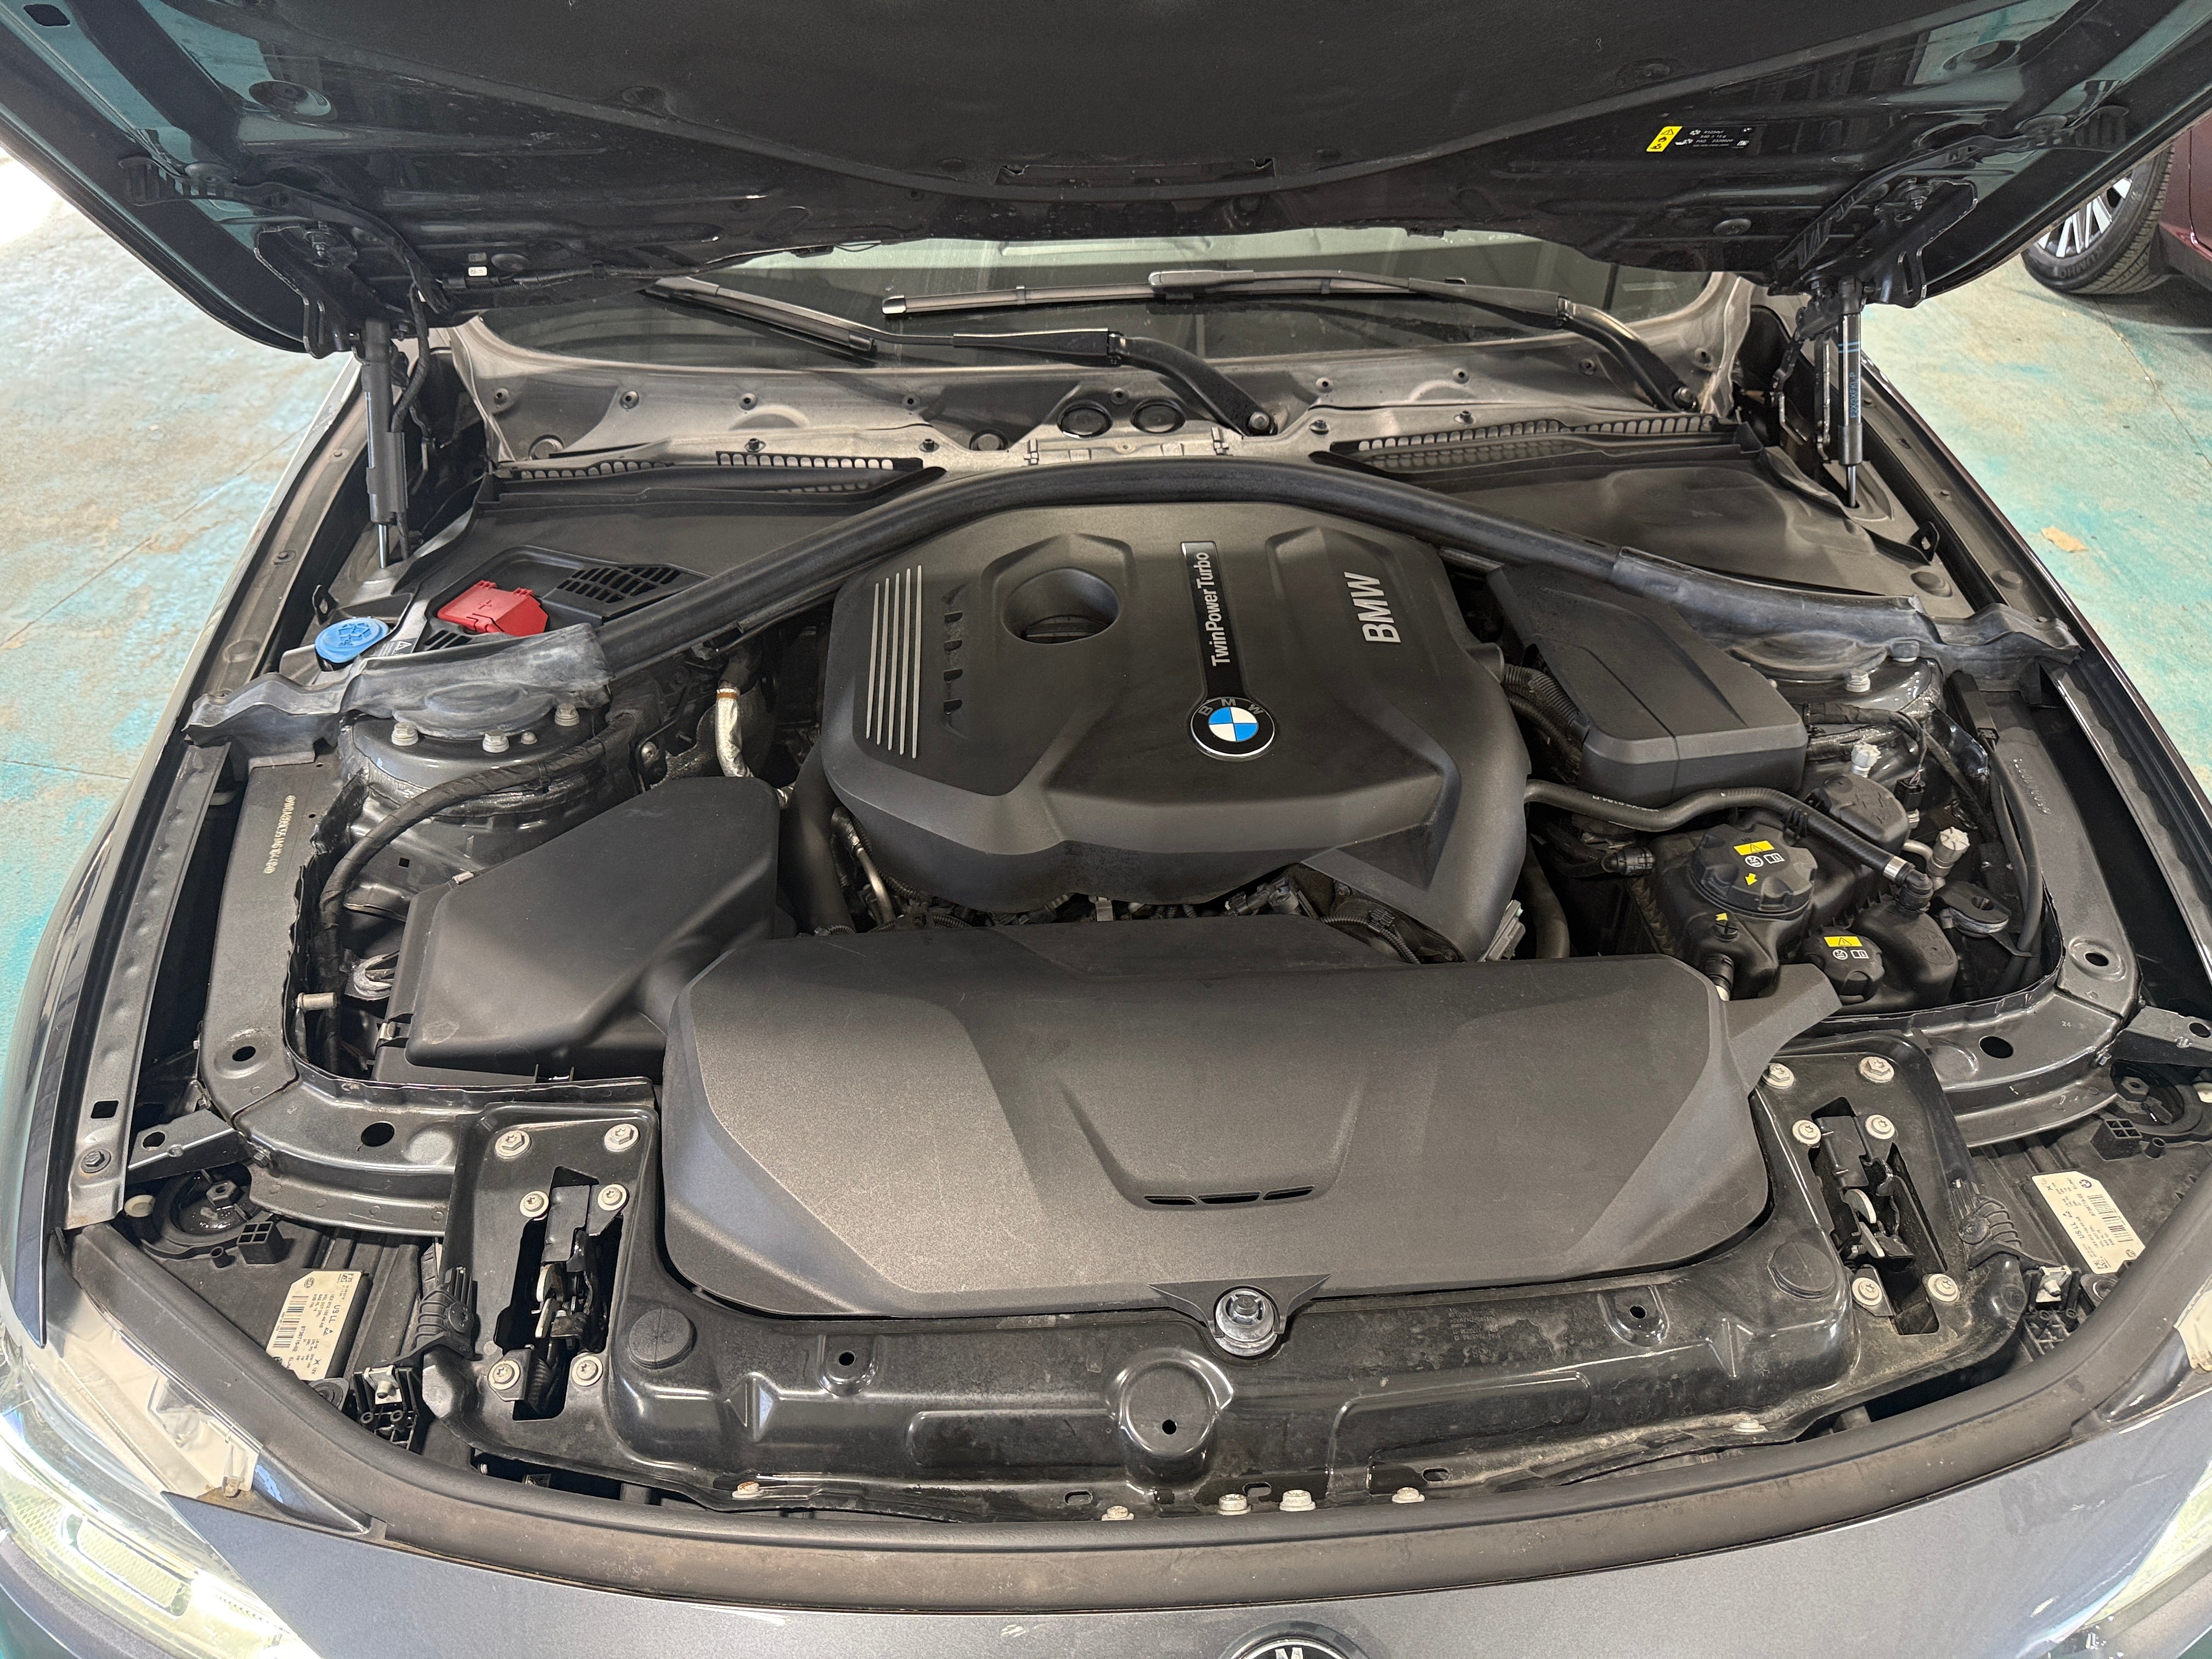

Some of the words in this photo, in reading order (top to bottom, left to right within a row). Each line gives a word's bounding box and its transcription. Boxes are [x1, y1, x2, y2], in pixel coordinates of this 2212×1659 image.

[2058, 245, 2103, 279] KUMHO
[1193, 552, 1215, 589] Turbo
[1344, 572, 1401, 643] BMW
[1198, 698, 1264, 716] BMW
[2070, 1221, 2079, 1229] LL
[2075, 1230, 2085, 1239] US
[332, 1305, 341, 1314] US
[329, 1315, 337, 1323] LL
